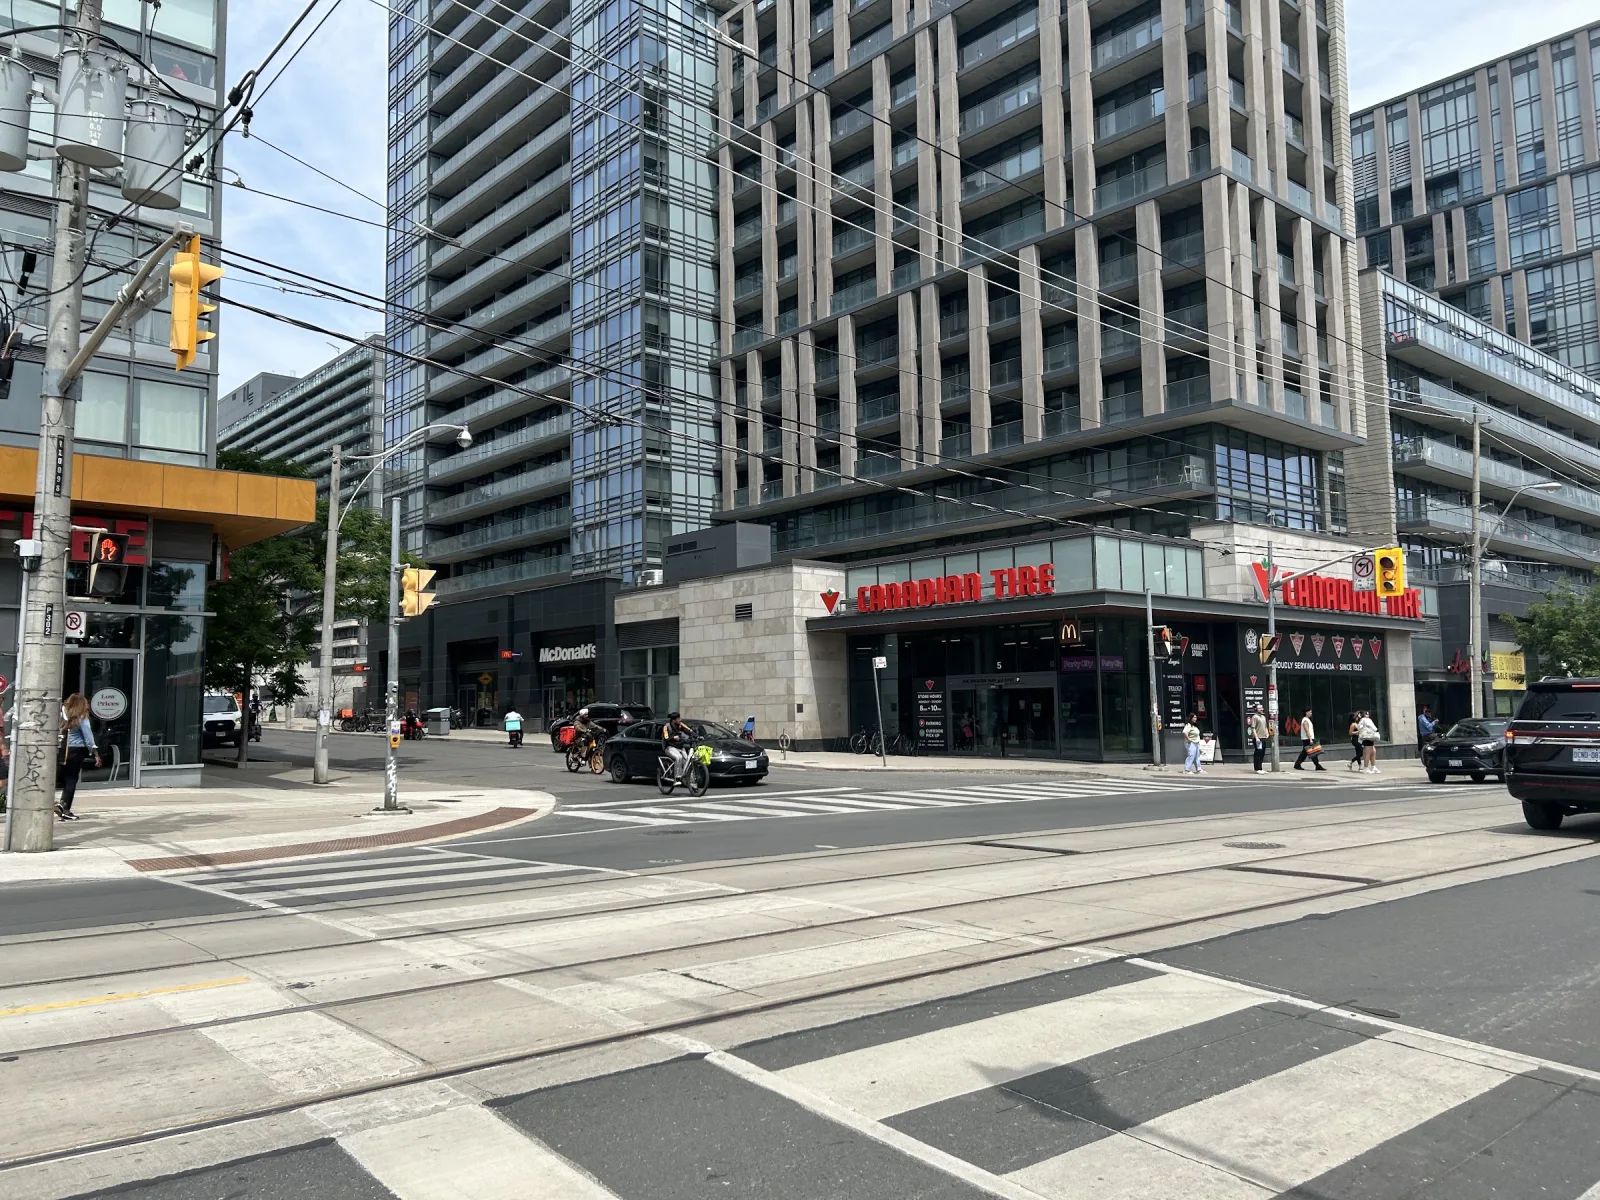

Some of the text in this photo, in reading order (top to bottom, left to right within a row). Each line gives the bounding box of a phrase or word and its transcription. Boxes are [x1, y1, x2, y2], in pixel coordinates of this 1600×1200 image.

[857, 563, 1055, 613] CANADIAN TIRE
[539, 643, 596, 662] McDonald's
[996, 661, 1002, 669] 5
[1294, 661, 1315, 670] SERVING
[1315, 661, 1335, 670] CANADA
[1339, 663, 1352, 671] SINCE
